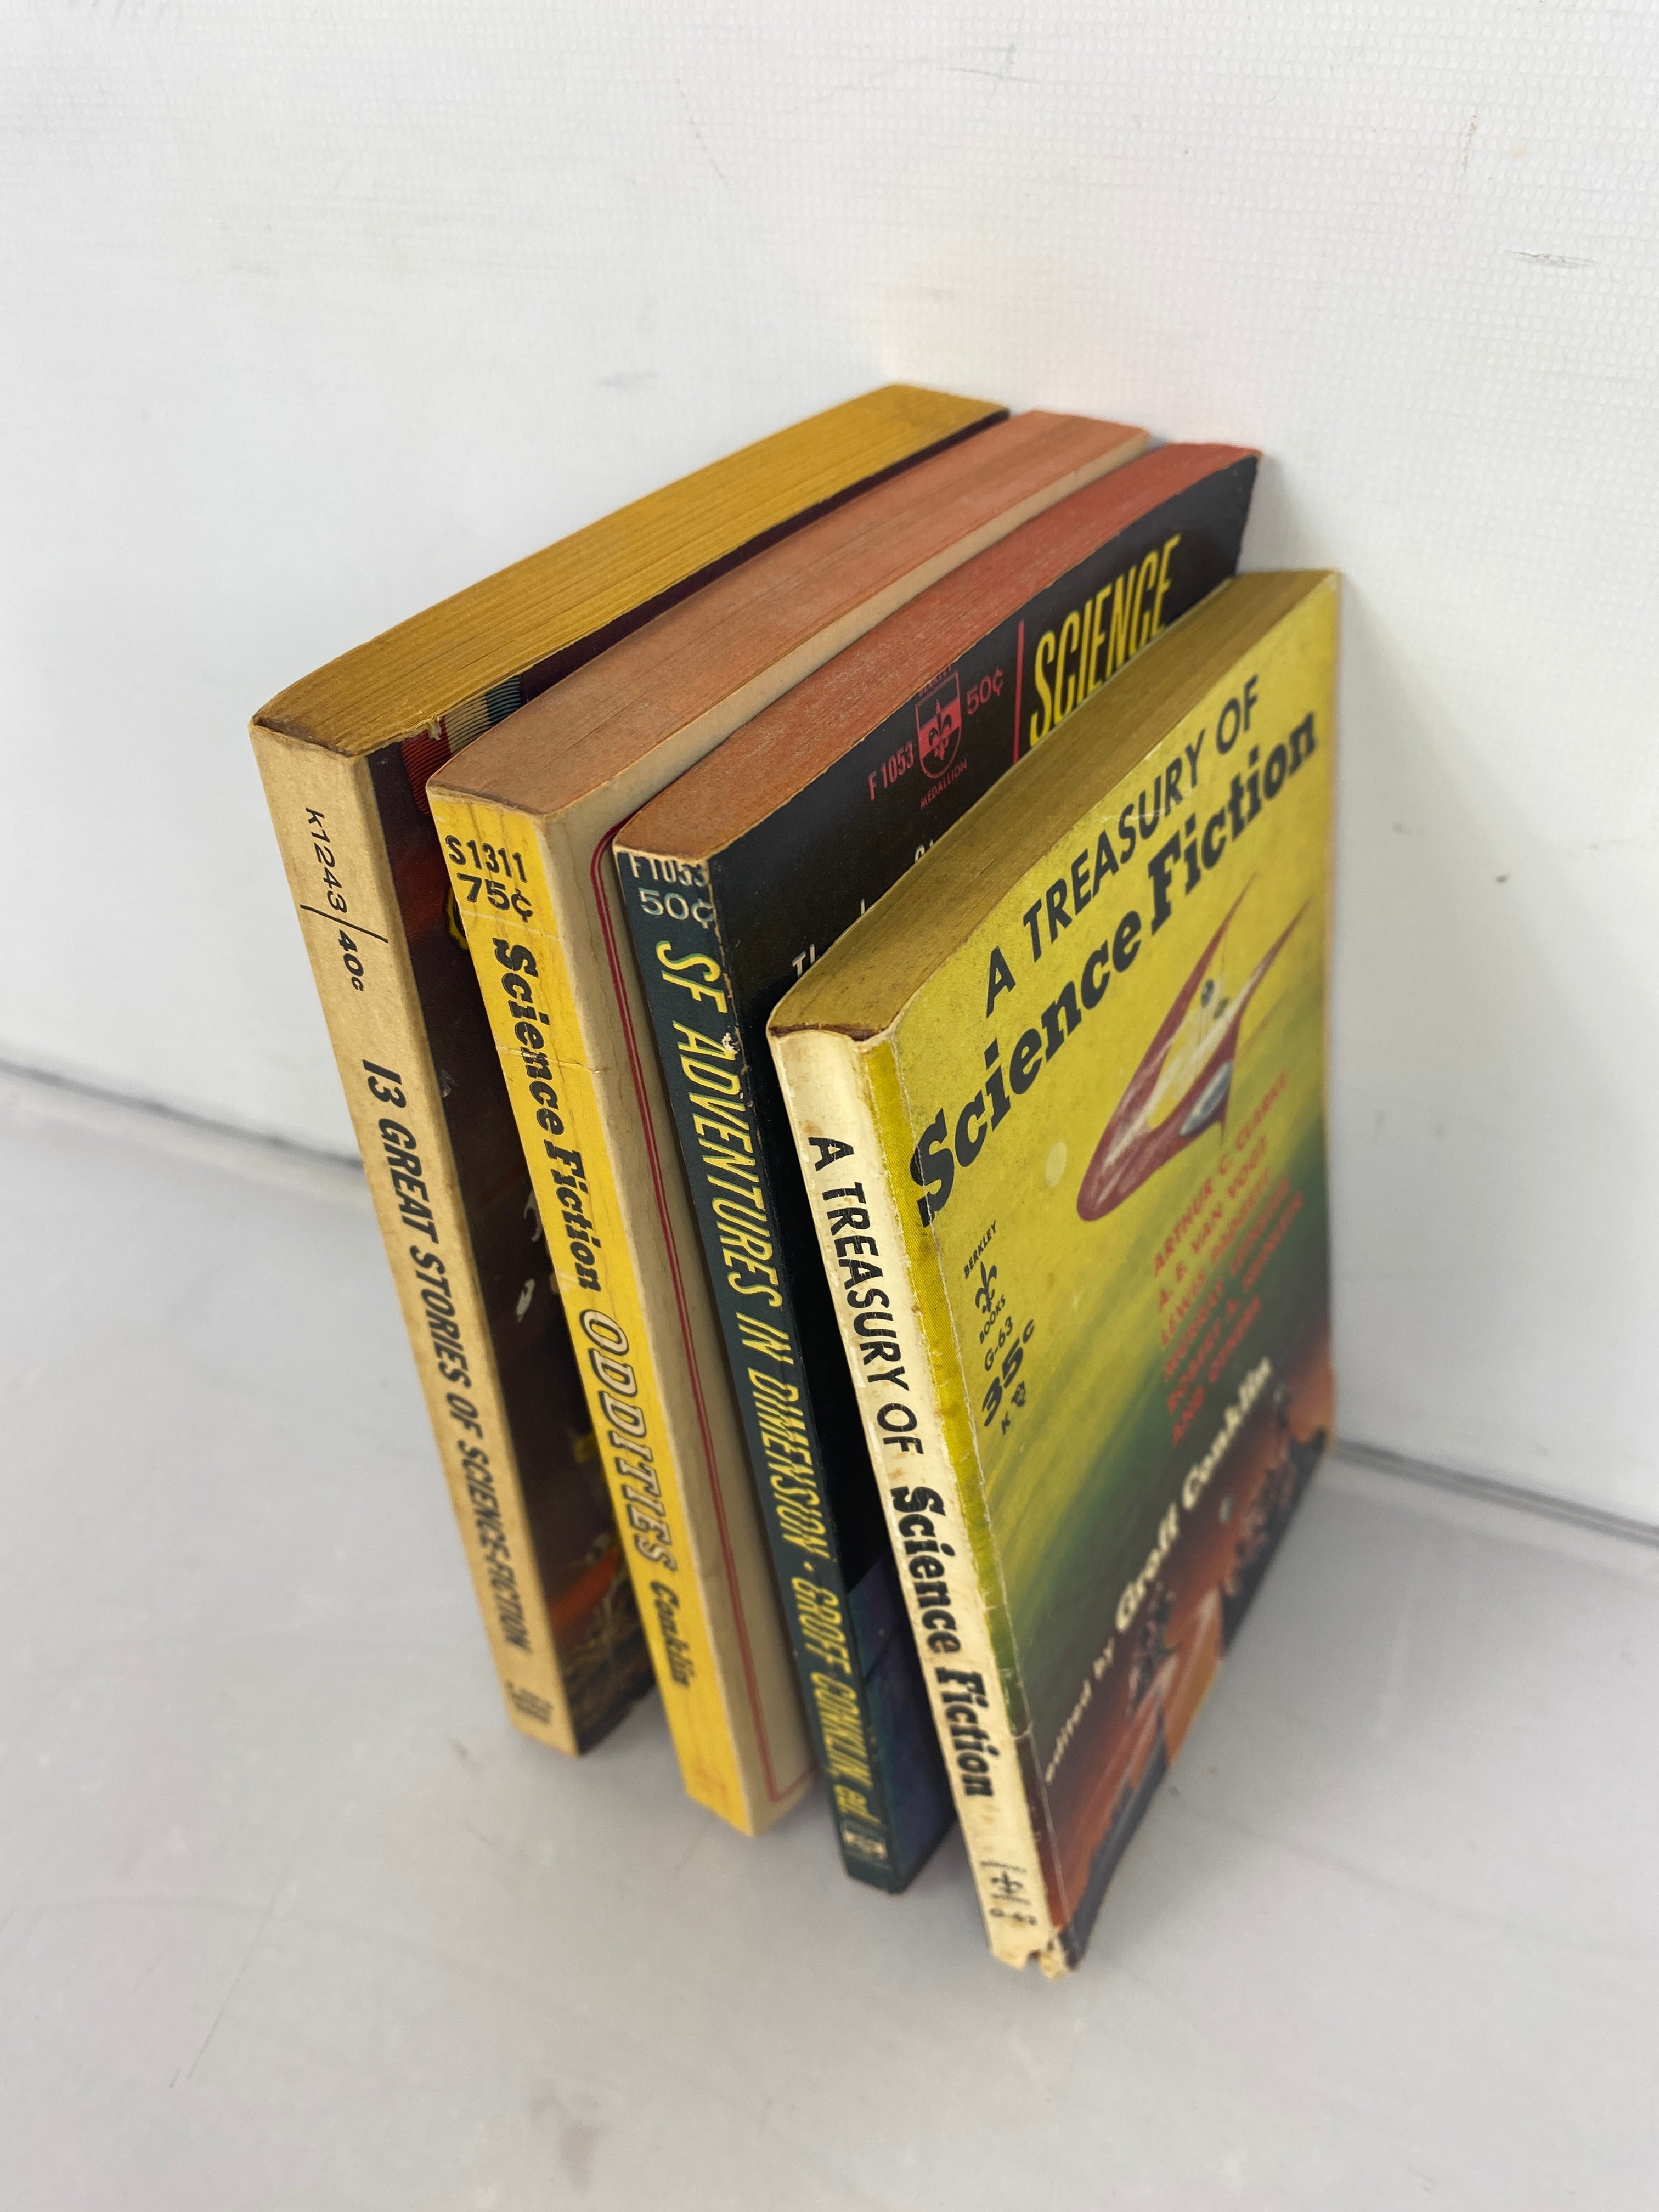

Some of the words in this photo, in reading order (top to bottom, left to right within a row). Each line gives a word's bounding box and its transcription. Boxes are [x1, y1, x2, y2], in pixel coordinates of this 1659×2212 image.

[1029, 534, 1181, 747] SCIENCE
[966, 667, 1003, 715] 50¢
[868, 771, 877, 801] F
[881, 742, 914, 788] 1053
[920, 757, 968, 811] MEDALLION
[445, 835, 525, 883] S1311
[986, 945, 1017, 1019] A
[1022, 728, 1205, 963] TREASURY
[1216, 675, 1259, 755] OF
[456, 872, 533, 922] 75¢
[638, 887, 714, 929] 50¢
[656, 940, 728, 1014] SF
[910, 909, 1142, 1228] Science
[1147, 710, 1317, 933] Fiction
[362, 1059, 407, 1108] 13
[378, 1118, 439, 1244] GREAT
[673, 1020, 783, 1307] ADVENTURES
[809, 1137, 854, 1171] A
[492, 936, 565, 1135] Science
[544, 1139, 602, 1292] Fiction
[579, 1308, 679, 1572] ODDITIES
[822, 1182, 910, 1391] TREASURY
[964, 1220, 996, 1279] BERKLEY
[409, 1245, 471, 1391] STORIES
[736, 1312, 794, 1364] IN
[979, 1294, 1006, 1345] BOOKS
[984, 1316, 1013, 1372] G-63
[446, 1393, 482, 1439] OF
[877, 1402, 924, 1455] OF
[748, 1367, 830, 1560] DIMENSION
[890, 1486, 961, 1654] Science
[1115, 1502, 1178, 1633] Groff
[792, 1577, 853, 1677] GROFF
[811, 1673, 873, 1791] CONKLIN
[934, 1666, 1000, 1798] Fiction
